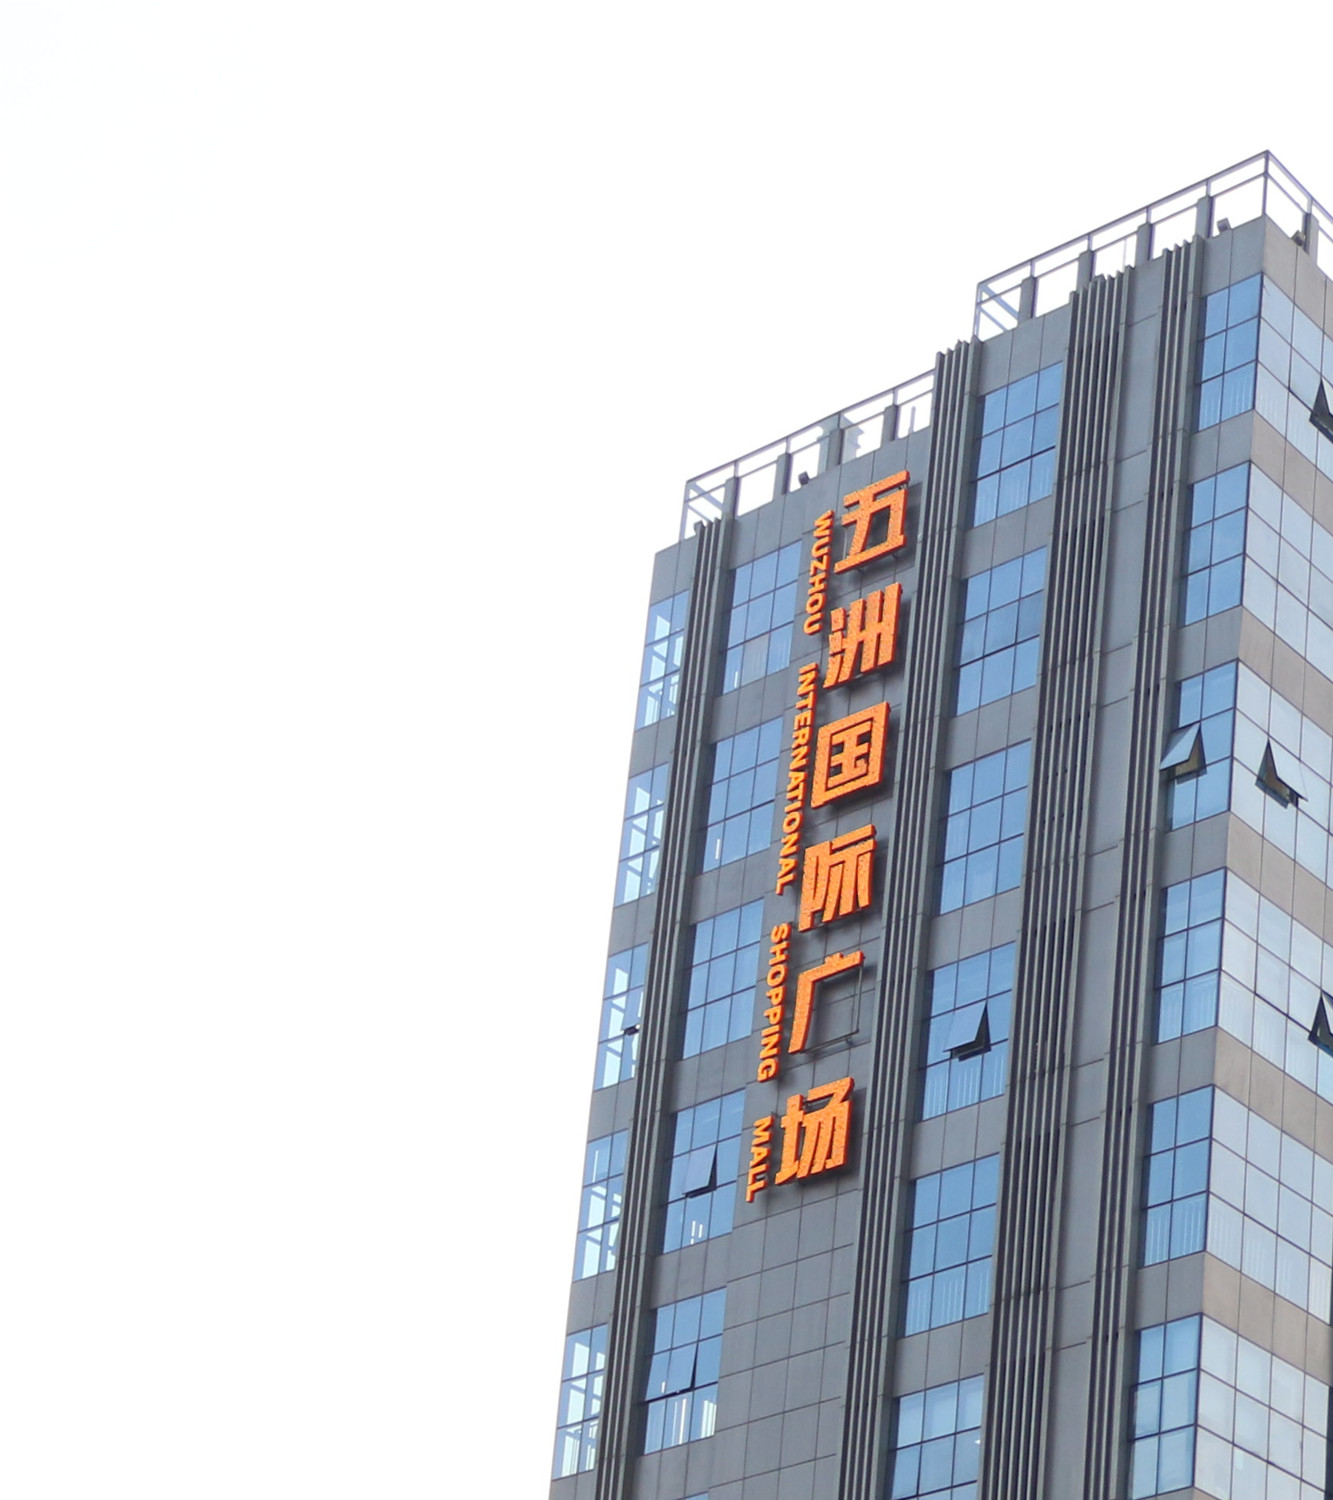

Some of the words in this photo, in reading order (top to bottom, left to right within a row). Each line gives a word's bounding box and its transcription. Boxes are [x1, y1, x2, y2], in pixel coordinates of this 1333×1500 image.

[803, 509, 834, 636] WUZHOU
[775, 661, 819, 896] INTERNATIONAL
[775, 469, 911, 1185] 五洲国际广场
[757, 922, 790, 1083] SHOPPING
[745, 1114, 773, 1204] MALL
